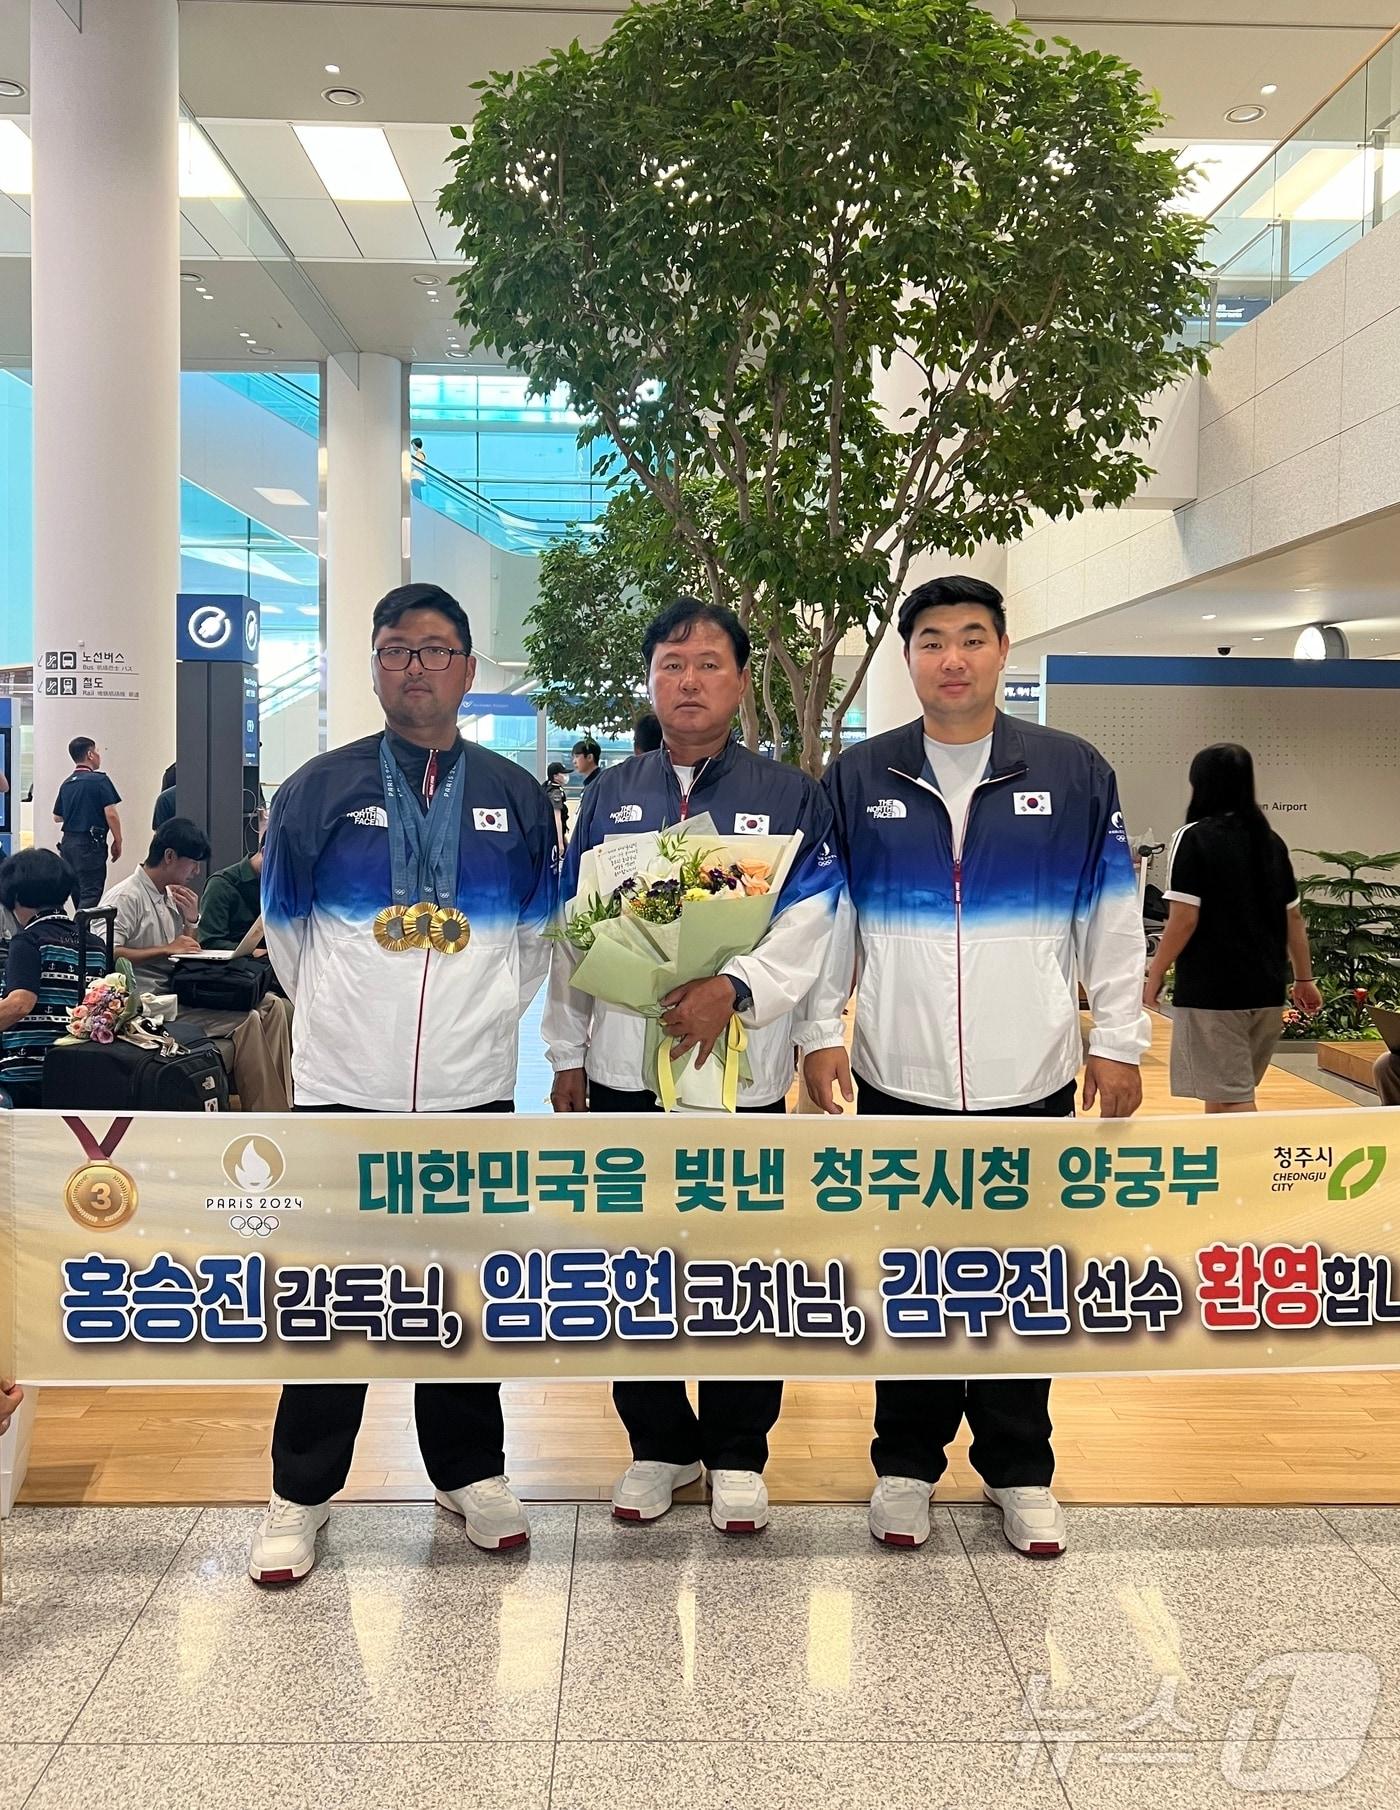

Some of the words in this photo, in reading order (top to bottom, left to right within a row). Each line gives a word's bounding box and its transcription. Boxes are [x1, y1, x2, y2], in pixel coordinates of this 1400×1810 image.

[82, 651, 125, 663] 노선버스
[83, 677, 103, 689] 철도
[878, 799, 893, 807] THE
[1272, 801, 1308, 812] Airport
[866, 805, 893, 813] NORTH
[873, 811, 892, 819] FACE
[354, 817, 376, 826] FACE
[1273, 1146, 1333, 1169] 청주시
[357, 1147, 647, 1214] 대한민국을
[674, 1147, 786, 1214] 빛낸
[810, 1145, 1031, 1213] 청주시청
[1058, 1145, 1220, 1210] 양궁부
[1272, 1172, 1327, 1182] CHEONGJU
[1271, 1182, 1294, 1192] CITY
[90, 1182, 112, 1210] 3
[259, 1197, 302, 1209] 2024
[61, 1252, 266, 1343] 홍승진
[274, 1262, 462, 1348] 감독님,
[480, 1247, 679, 1342] 임동현
[684, 1258, 866, 1345] 코치님,
[879, 1244, 1071, 1338] 김우진
[1075, 1256, 1183, 1333] 선수
